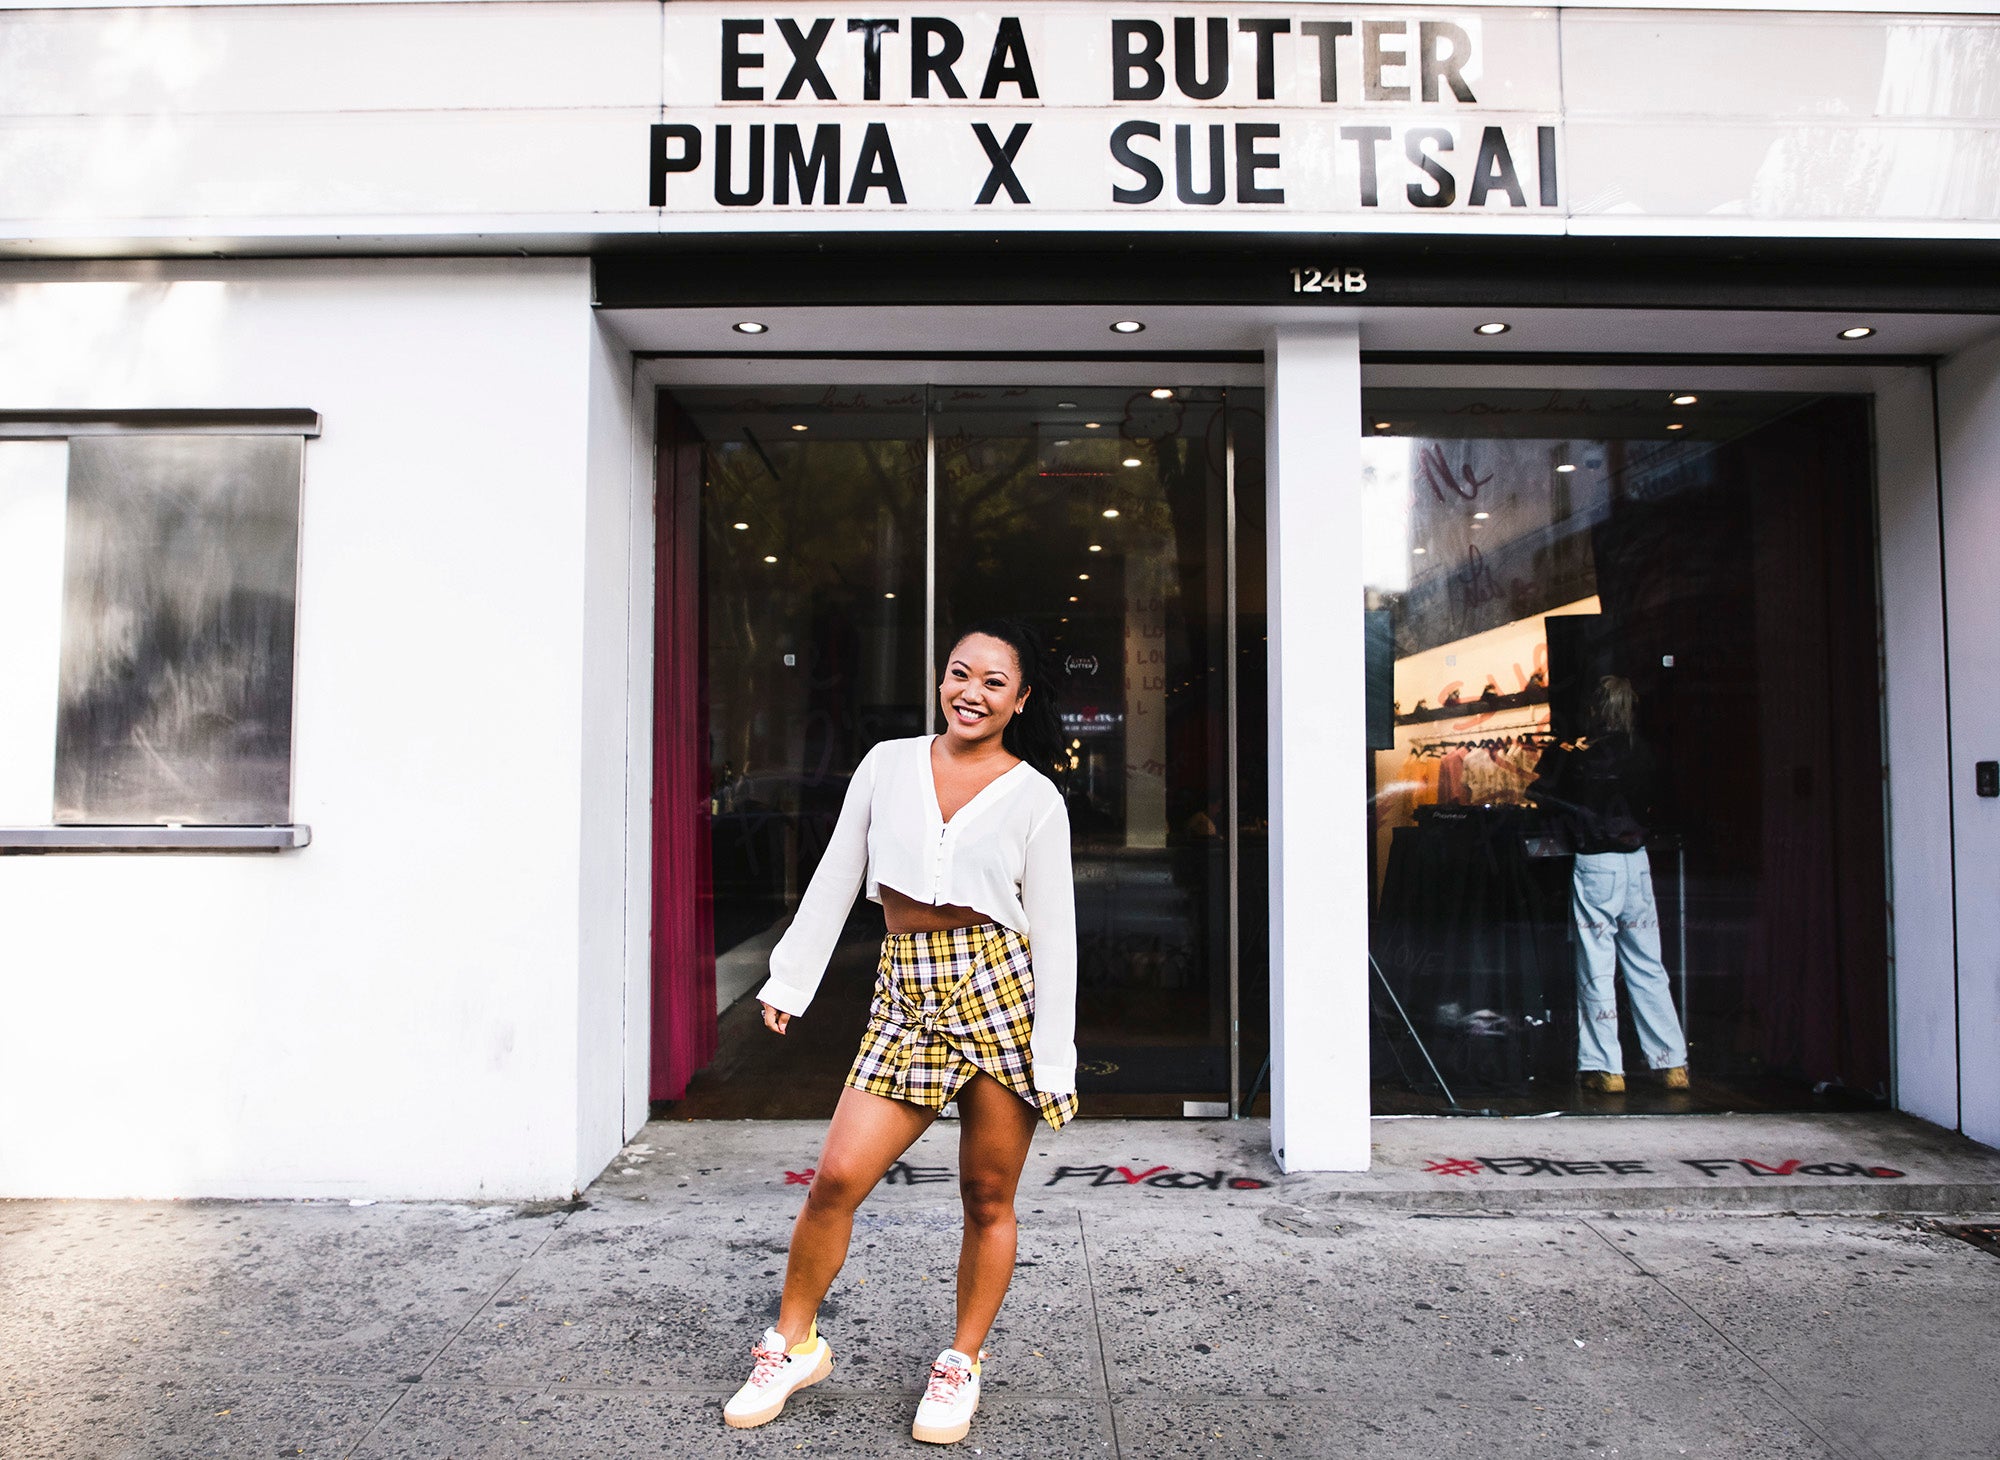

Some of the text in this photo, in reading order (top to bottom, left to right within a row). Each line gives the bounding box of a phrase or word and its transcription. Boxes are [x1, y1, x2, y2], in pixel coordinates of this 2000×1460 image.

[721, 16, 1479, 104] EXTRA BUTTER
[648, 120, 1559, 209] PUMA X SUE TSAI
[1290, 267, 1368, 294] 124B
